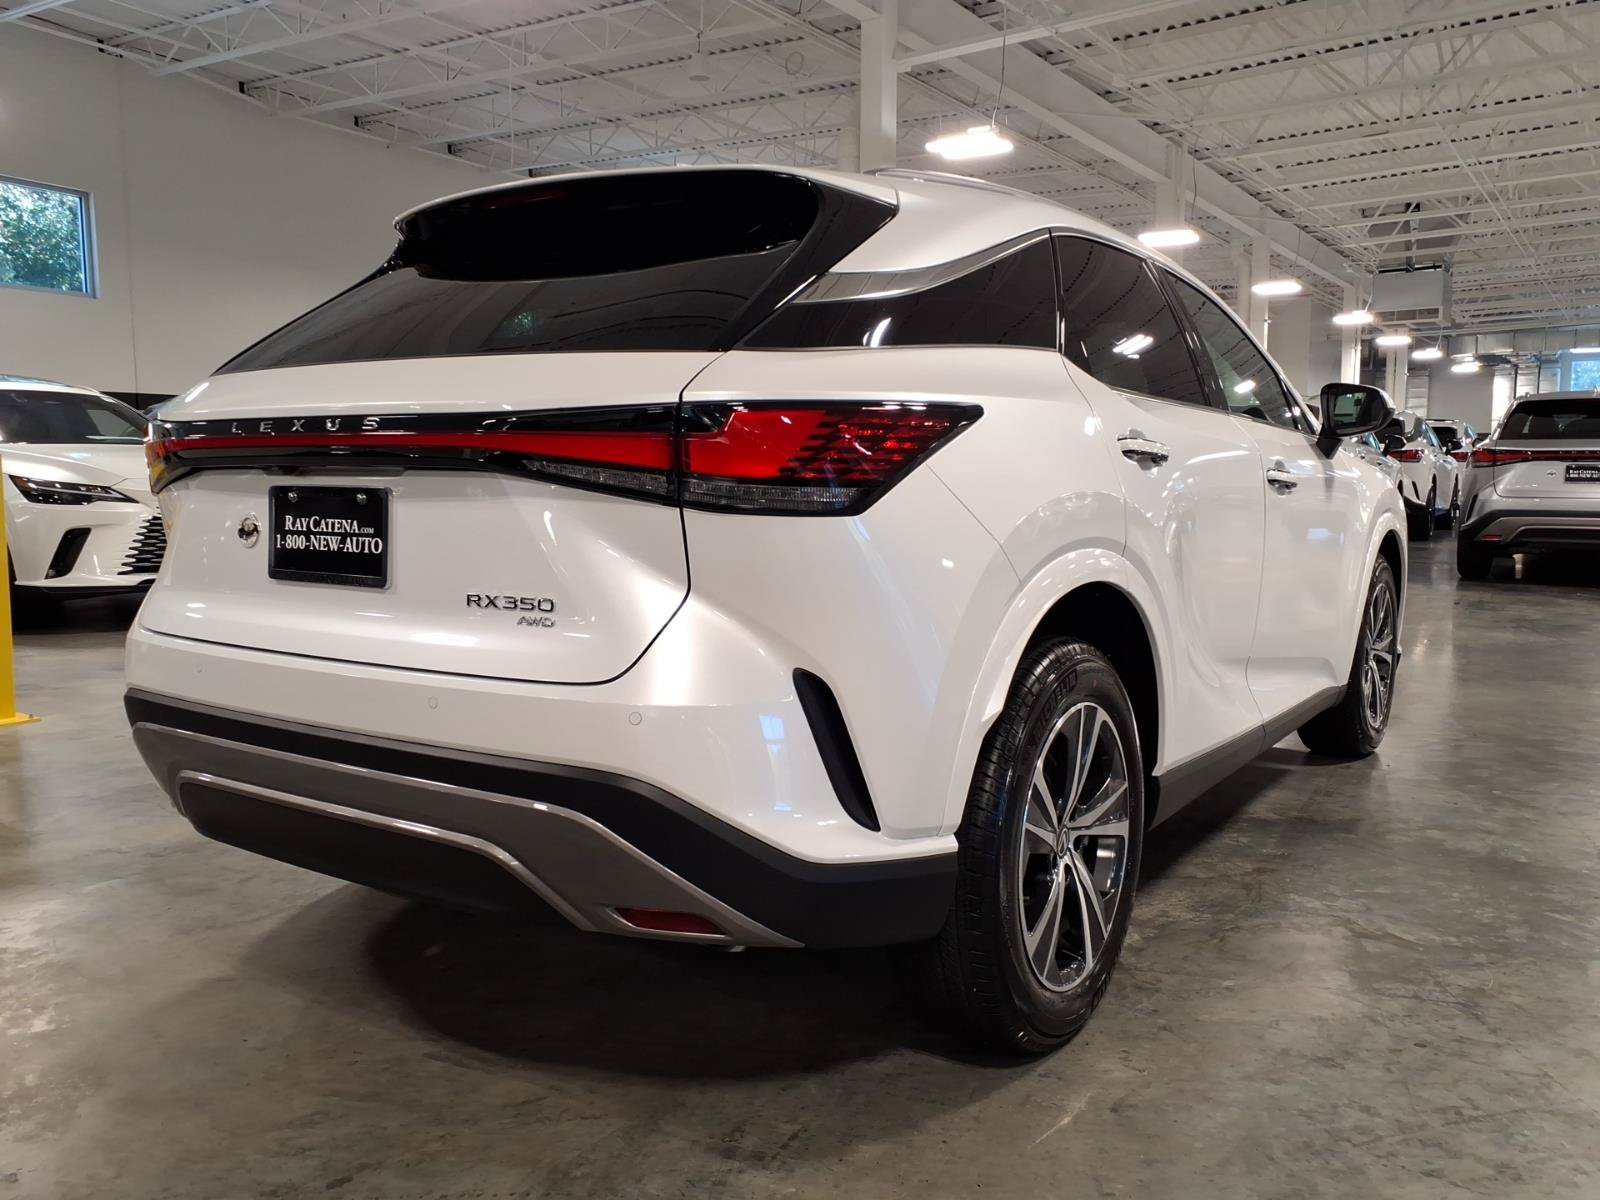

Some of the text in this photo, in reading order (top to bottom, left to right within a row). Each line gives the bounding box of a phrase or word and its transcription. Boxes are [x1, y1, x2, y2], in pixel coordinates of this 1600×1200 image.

[231, 417, 380, 434] LEXUS
[276, 534, 383, 554] 1-800-NEW-AUTO
[516, 616, 555, 628] AWD
